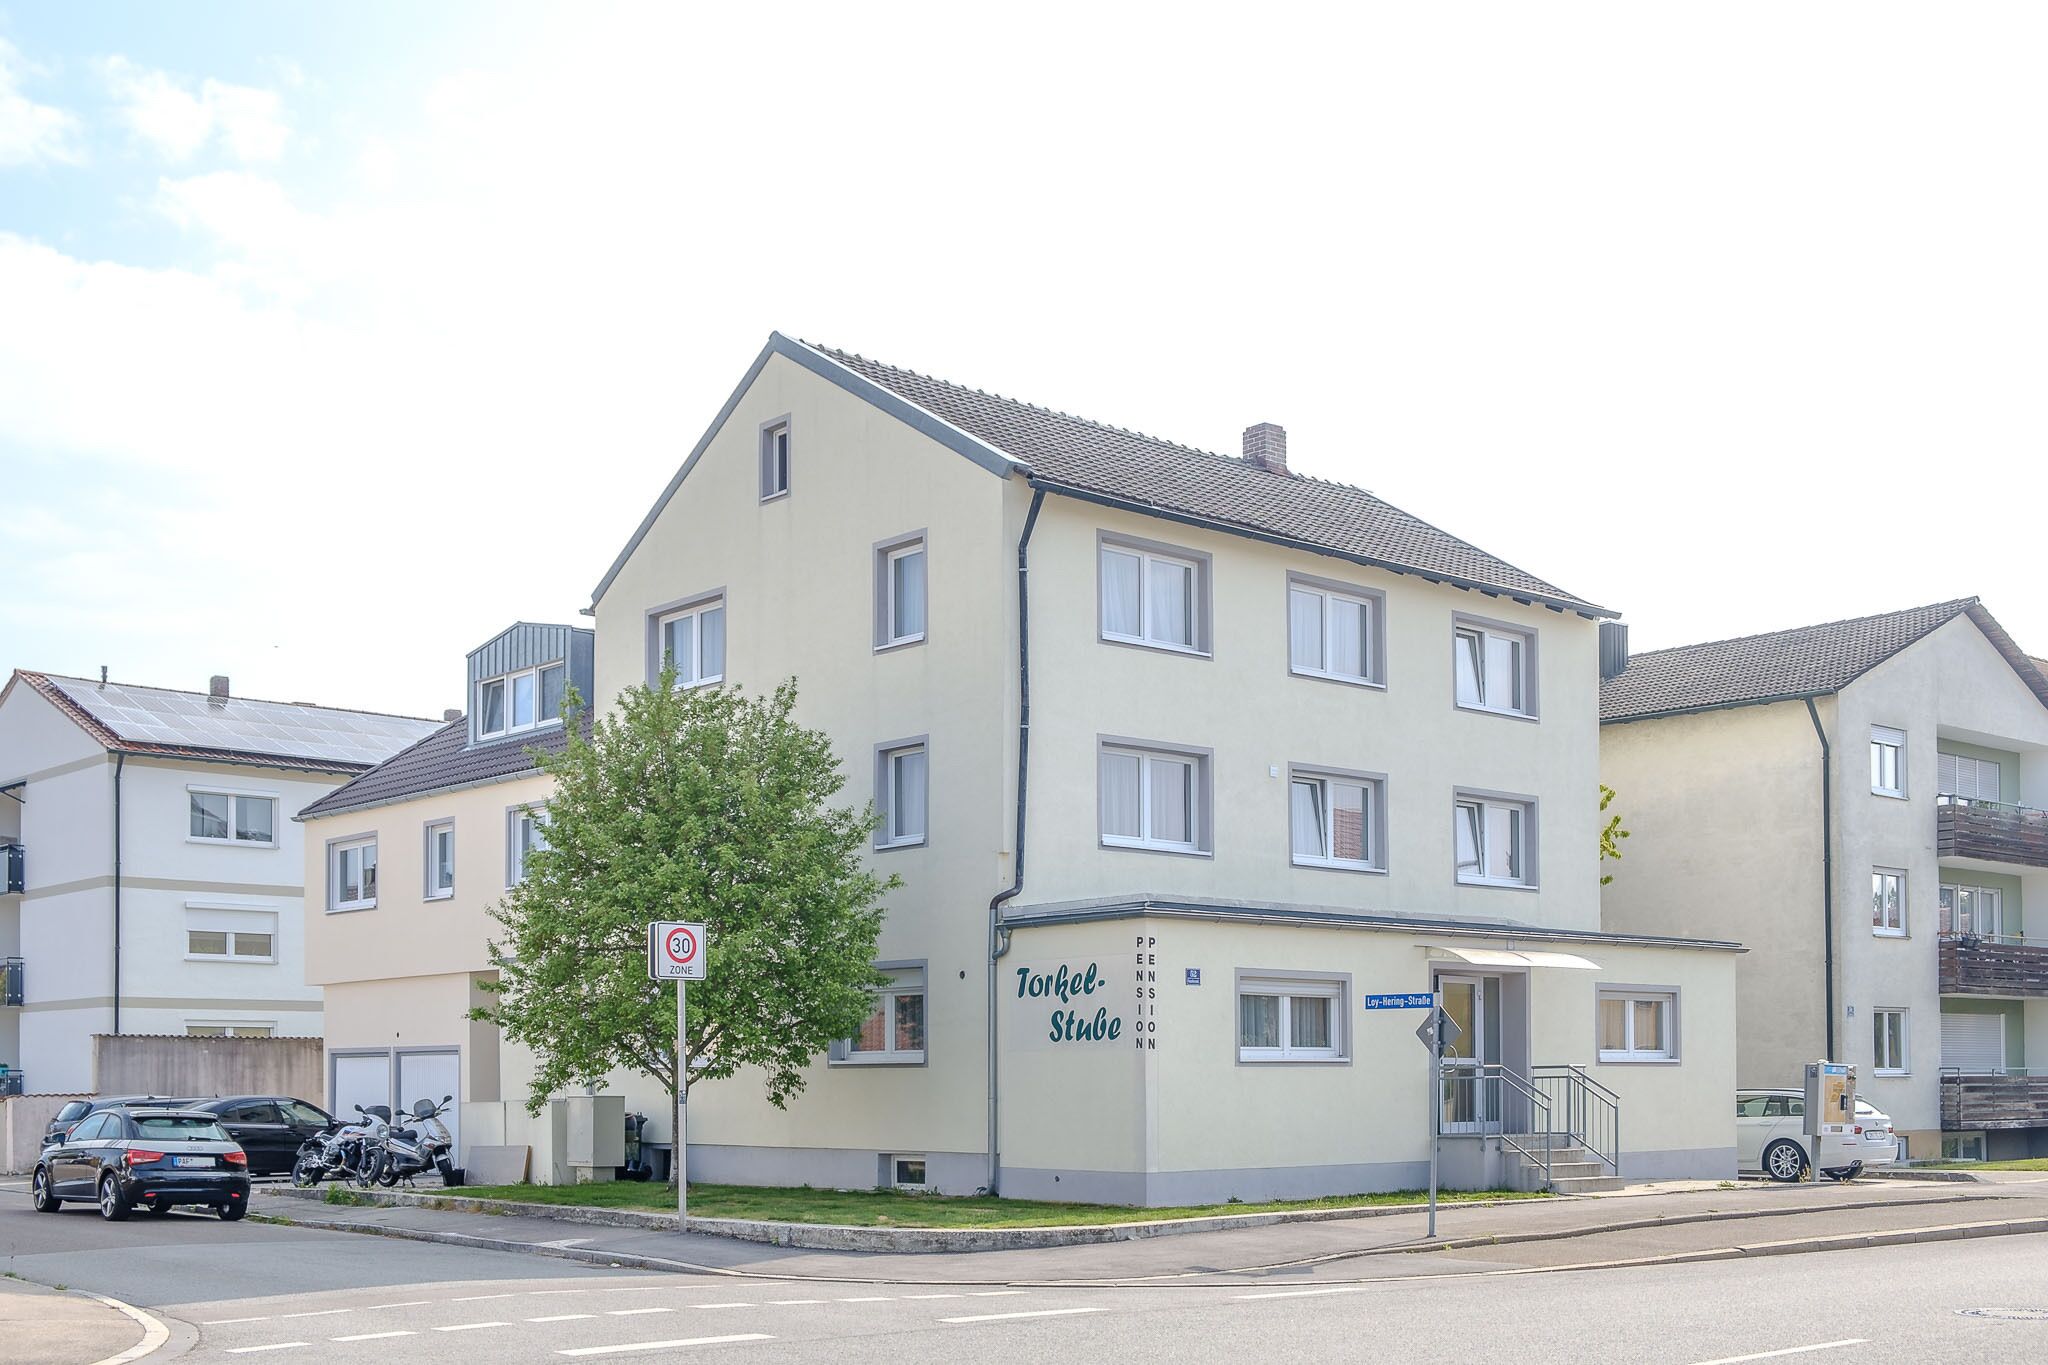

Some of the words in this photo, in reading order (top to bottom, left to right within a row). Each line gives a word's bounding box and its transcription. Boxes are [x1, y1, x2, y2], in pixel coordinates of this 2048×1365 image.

[672, 937, 690, 953] 30
[669, 965, 693, 975] ZONE
[1016, 962, 1105, 1004] Torkel-
[1136, 936, 1144, 1049] PENSION
[1148, 937, 1156, 1050] PENSION
[1367, 995, 1431, 1008] Loy-Hering-Straße
[1049, 1006, 1122, 1043] Stube
